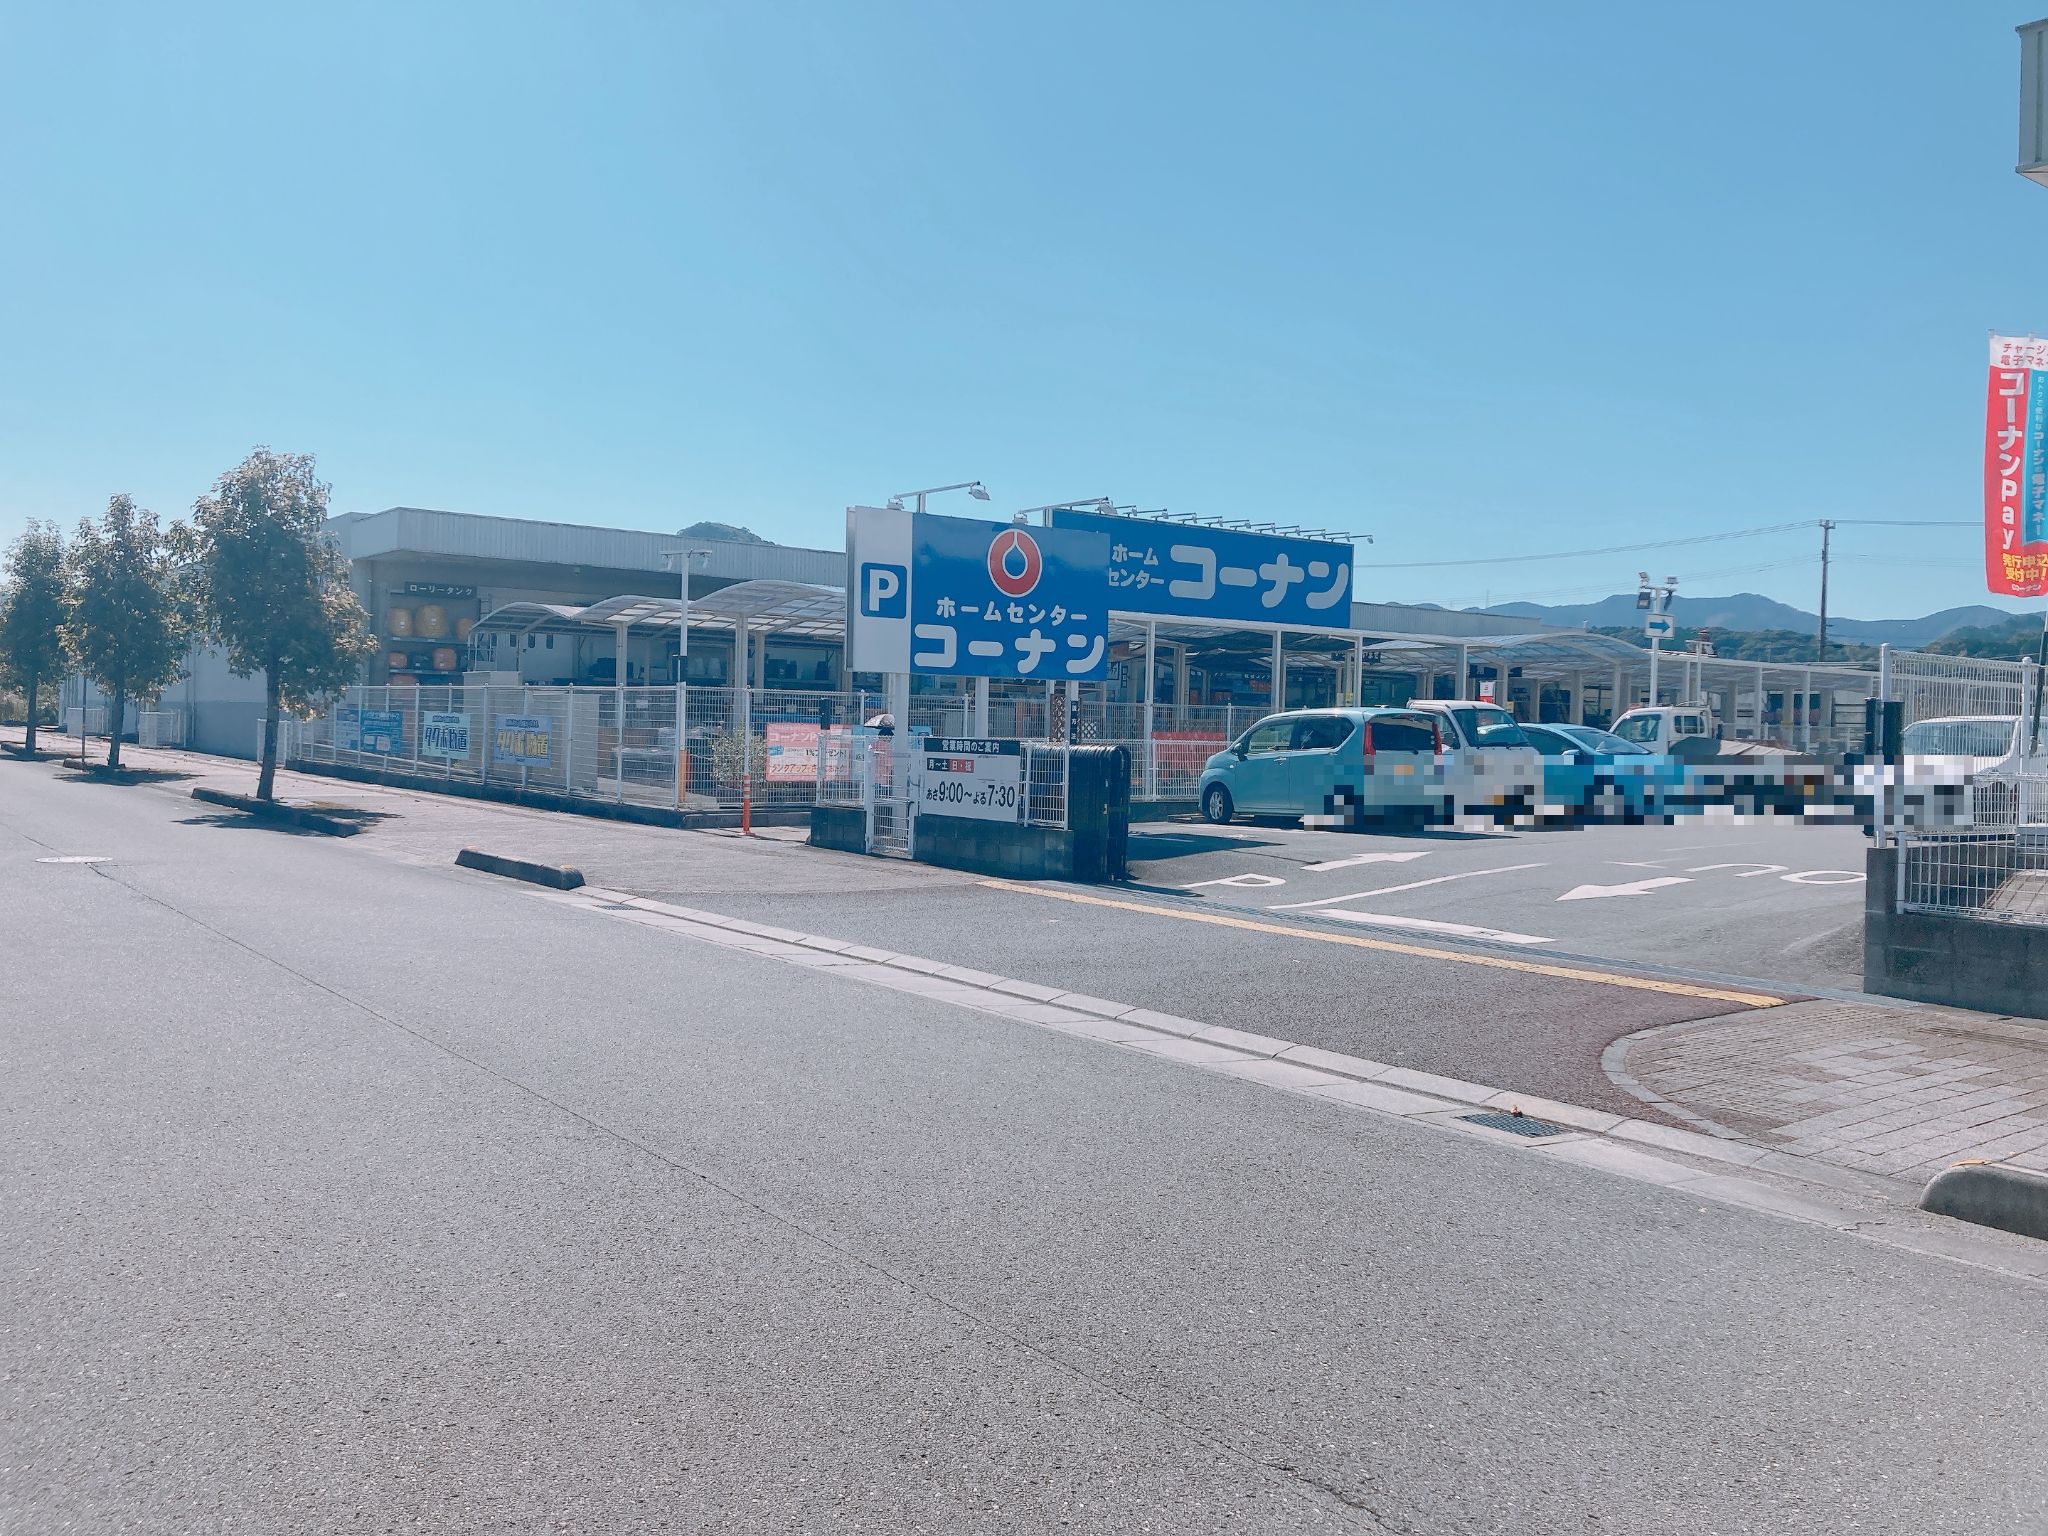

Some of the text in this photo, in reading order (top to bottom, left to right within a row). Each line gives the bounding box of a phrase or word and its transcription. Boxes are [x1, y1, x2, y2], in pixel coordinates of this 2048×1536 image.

[2003, 343, 2048, 355] チャージ
[2001, 355, 2048, 367] 電子マネ
[1997, 372, 2024, 550] コーナンPay
[1111, 543, 1159, 566] ホーム
[1108, 567, 1165, 590] センター
[1169, 544, 1350, 610] コーナン
[409, 584, 473, 596] ローリータンク
[868, 568, 900, 612] P
[936, 596, 1088, 627] ホームセンター
[914, 623, 1105, 674] コーナン
[941, 740, 1001, 754] 営業時間のご案内
